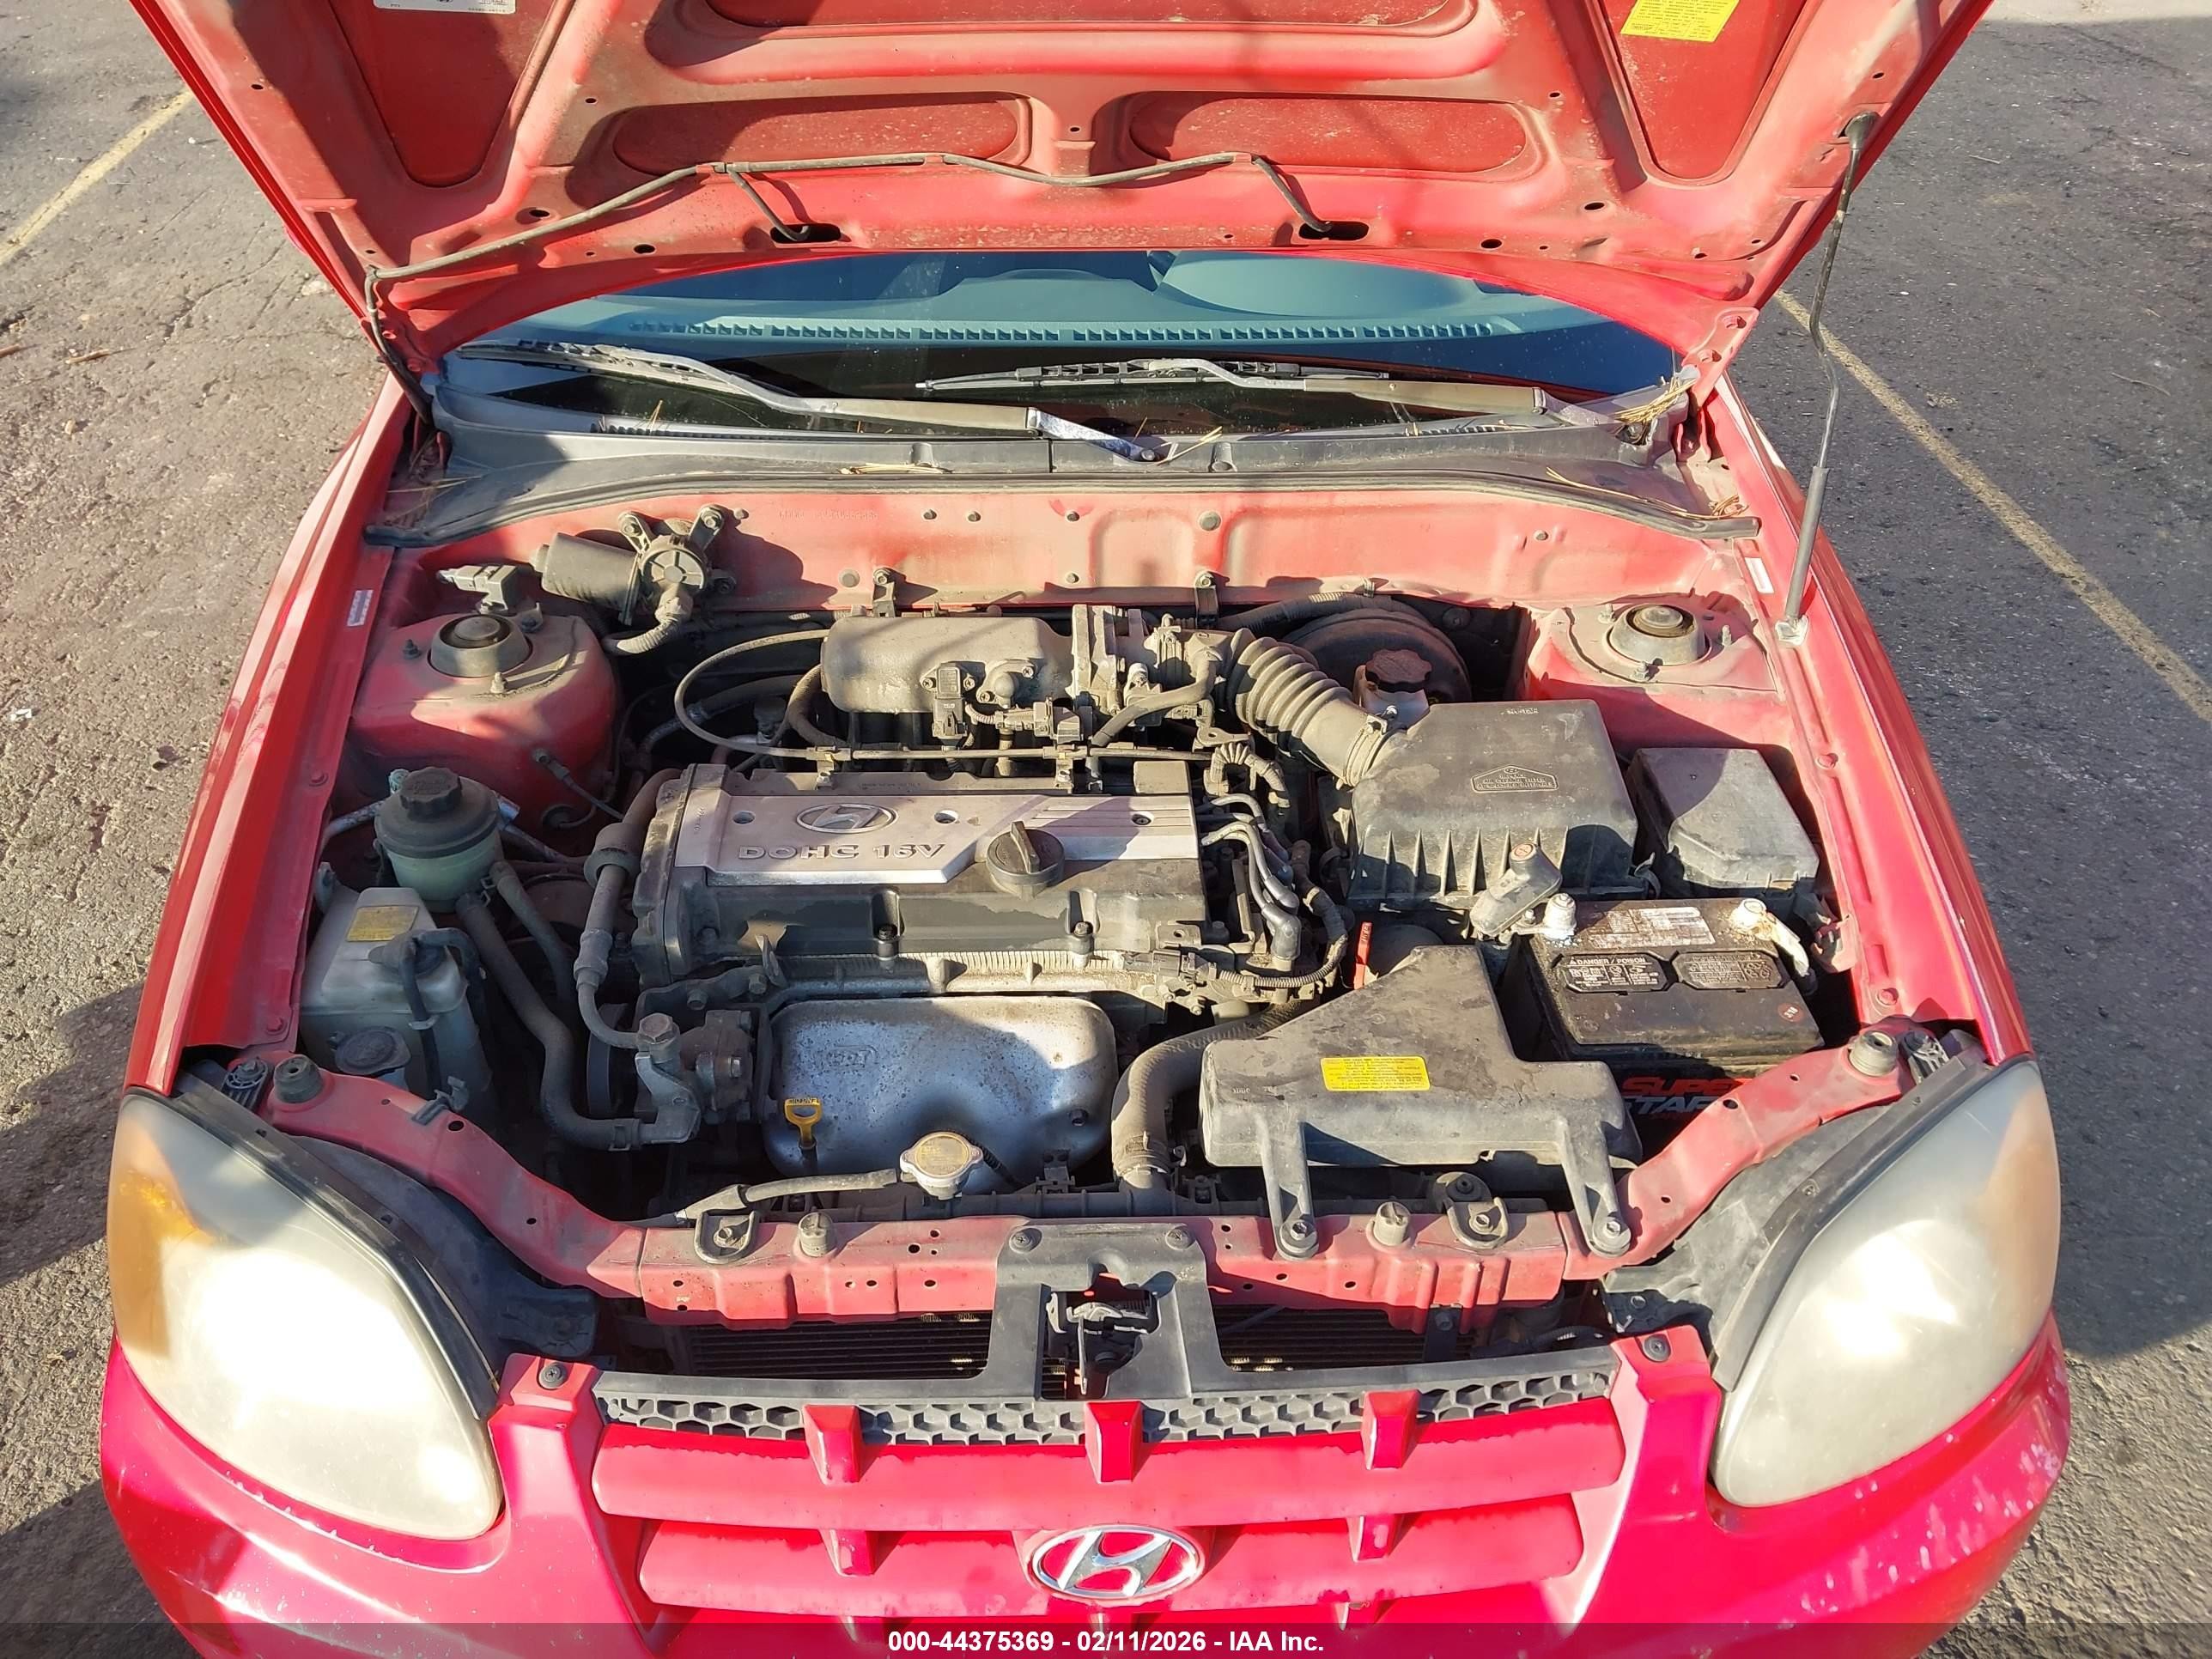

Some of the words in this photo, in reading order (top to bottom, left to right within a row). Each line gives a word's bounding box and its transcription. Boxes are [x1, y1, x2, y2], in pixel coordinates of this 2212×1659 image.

[738, 845, 859, 860] DOHC
[872, 844, 946, 859] 16V
[1621, 1076, 1743, 1096] SUPE
